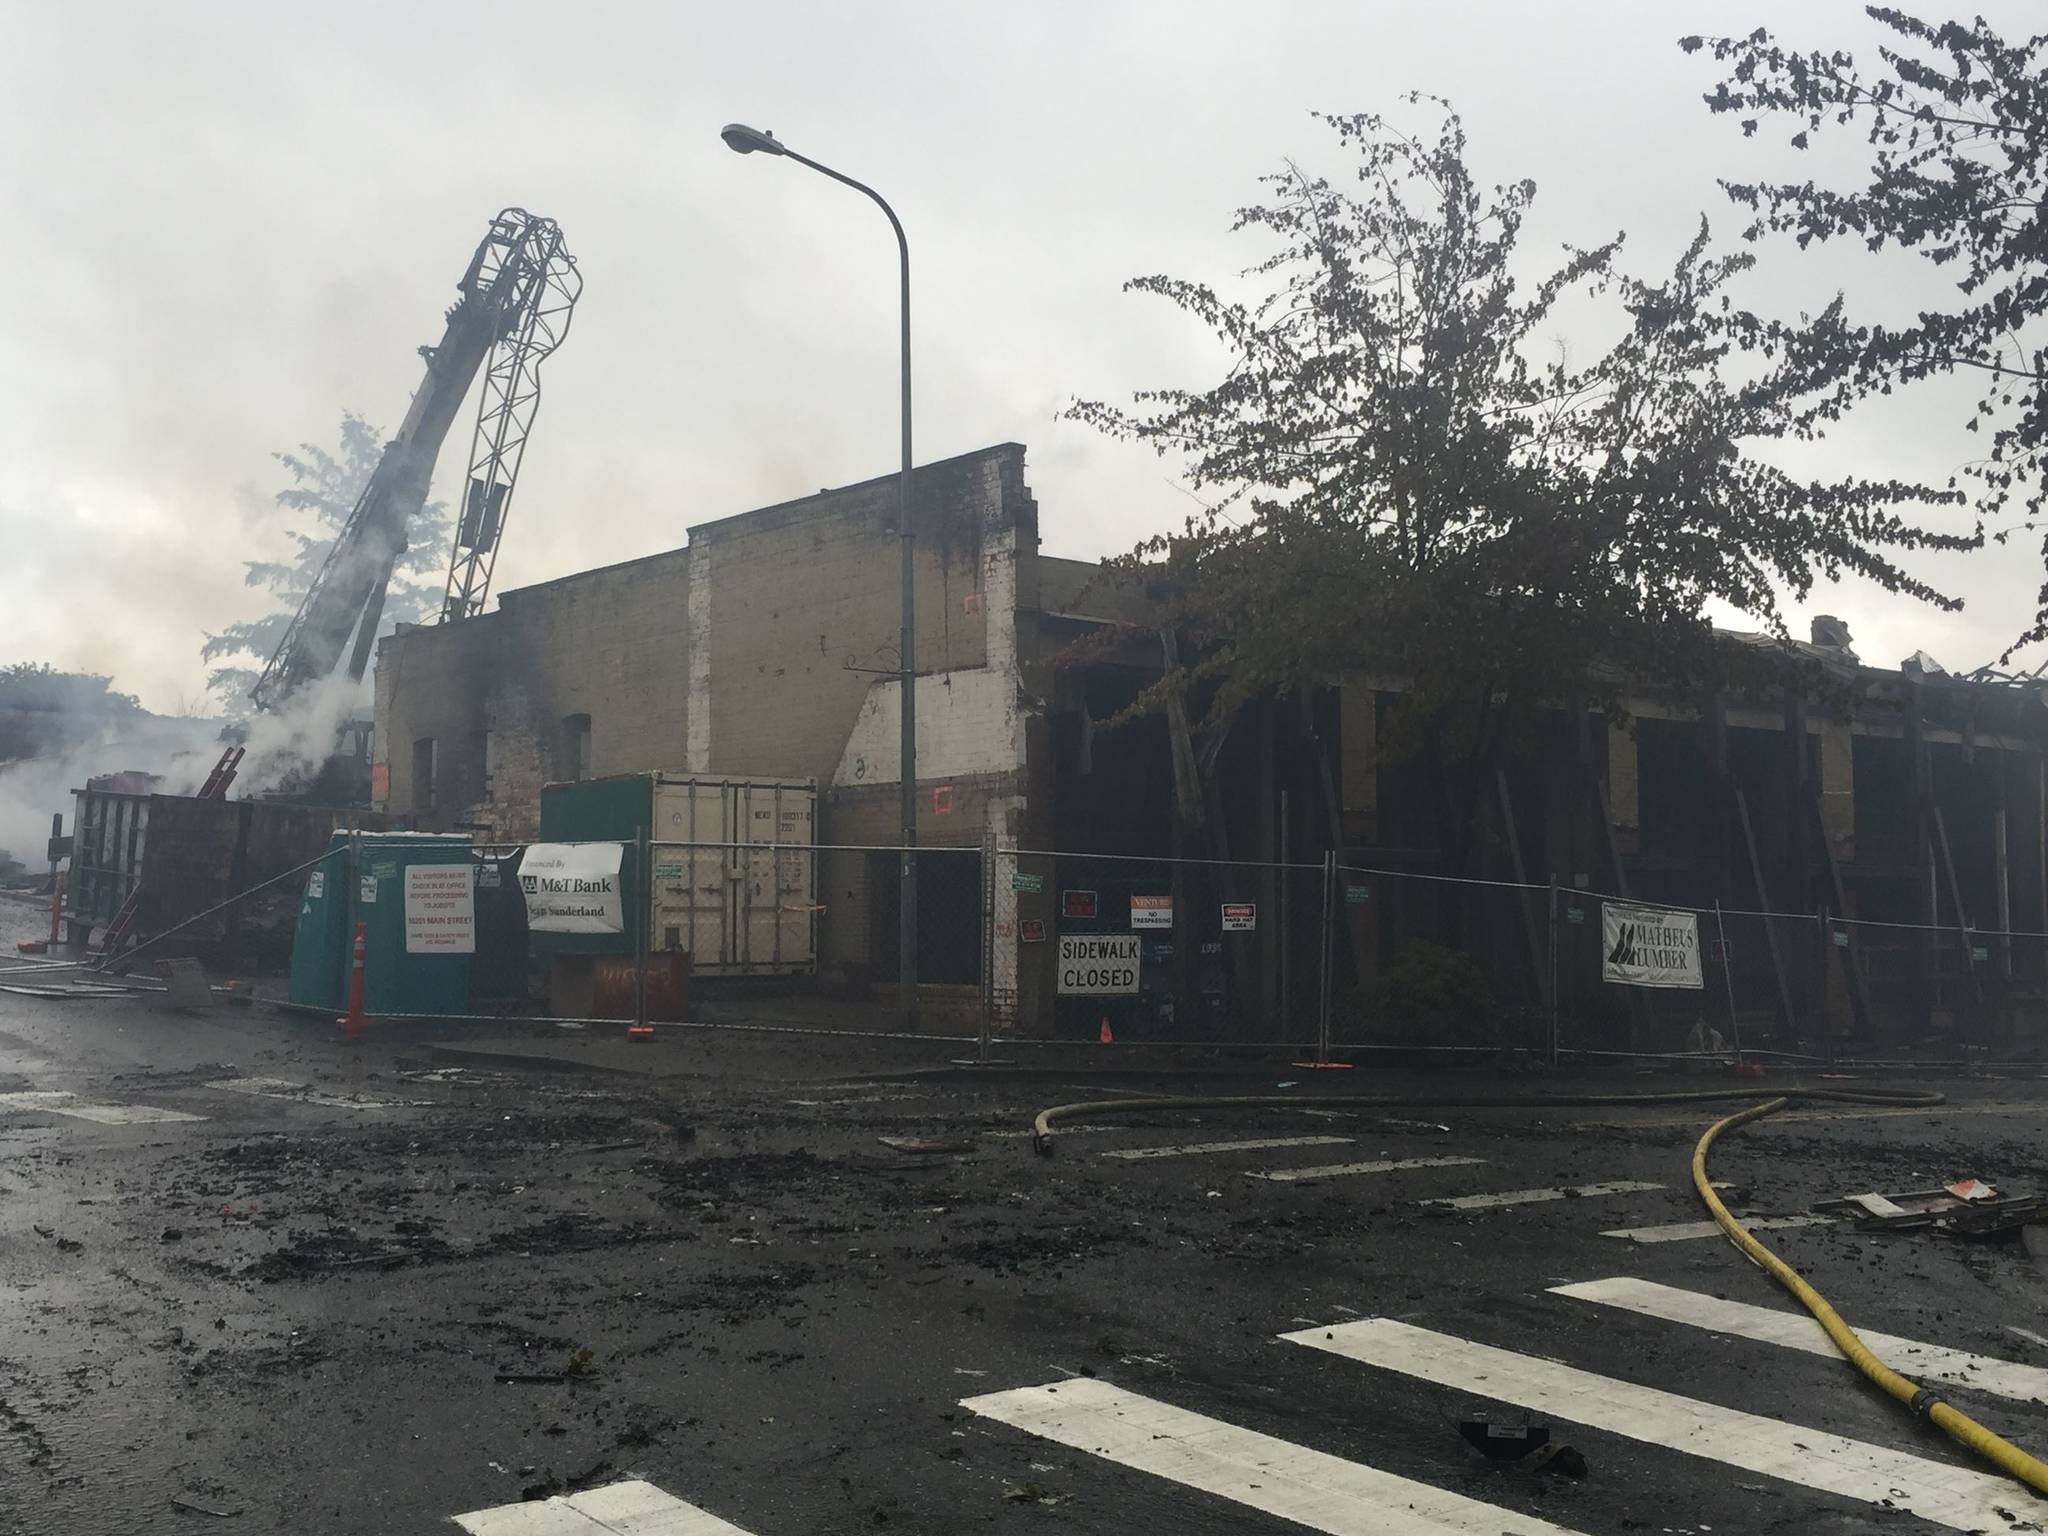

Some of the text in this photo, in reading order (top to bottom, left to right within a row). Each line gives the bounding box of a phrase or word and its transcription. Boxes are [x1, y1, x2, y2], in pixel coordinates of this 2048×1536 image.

[541, 878, 612, 892] M&T Bank
[548, 906, 605, 917] Sunderland
[427, 917, 446, 925] MAIN
[447, 917, 472, 925] STREET
[1637, 924, 1694, 948] MATHEUS
[1062, 941, 1137, 959] SIDEWALK
[1637, 947, 1688, 970] LUMBER
[1064, 969, 1134, 987] CLOSED
